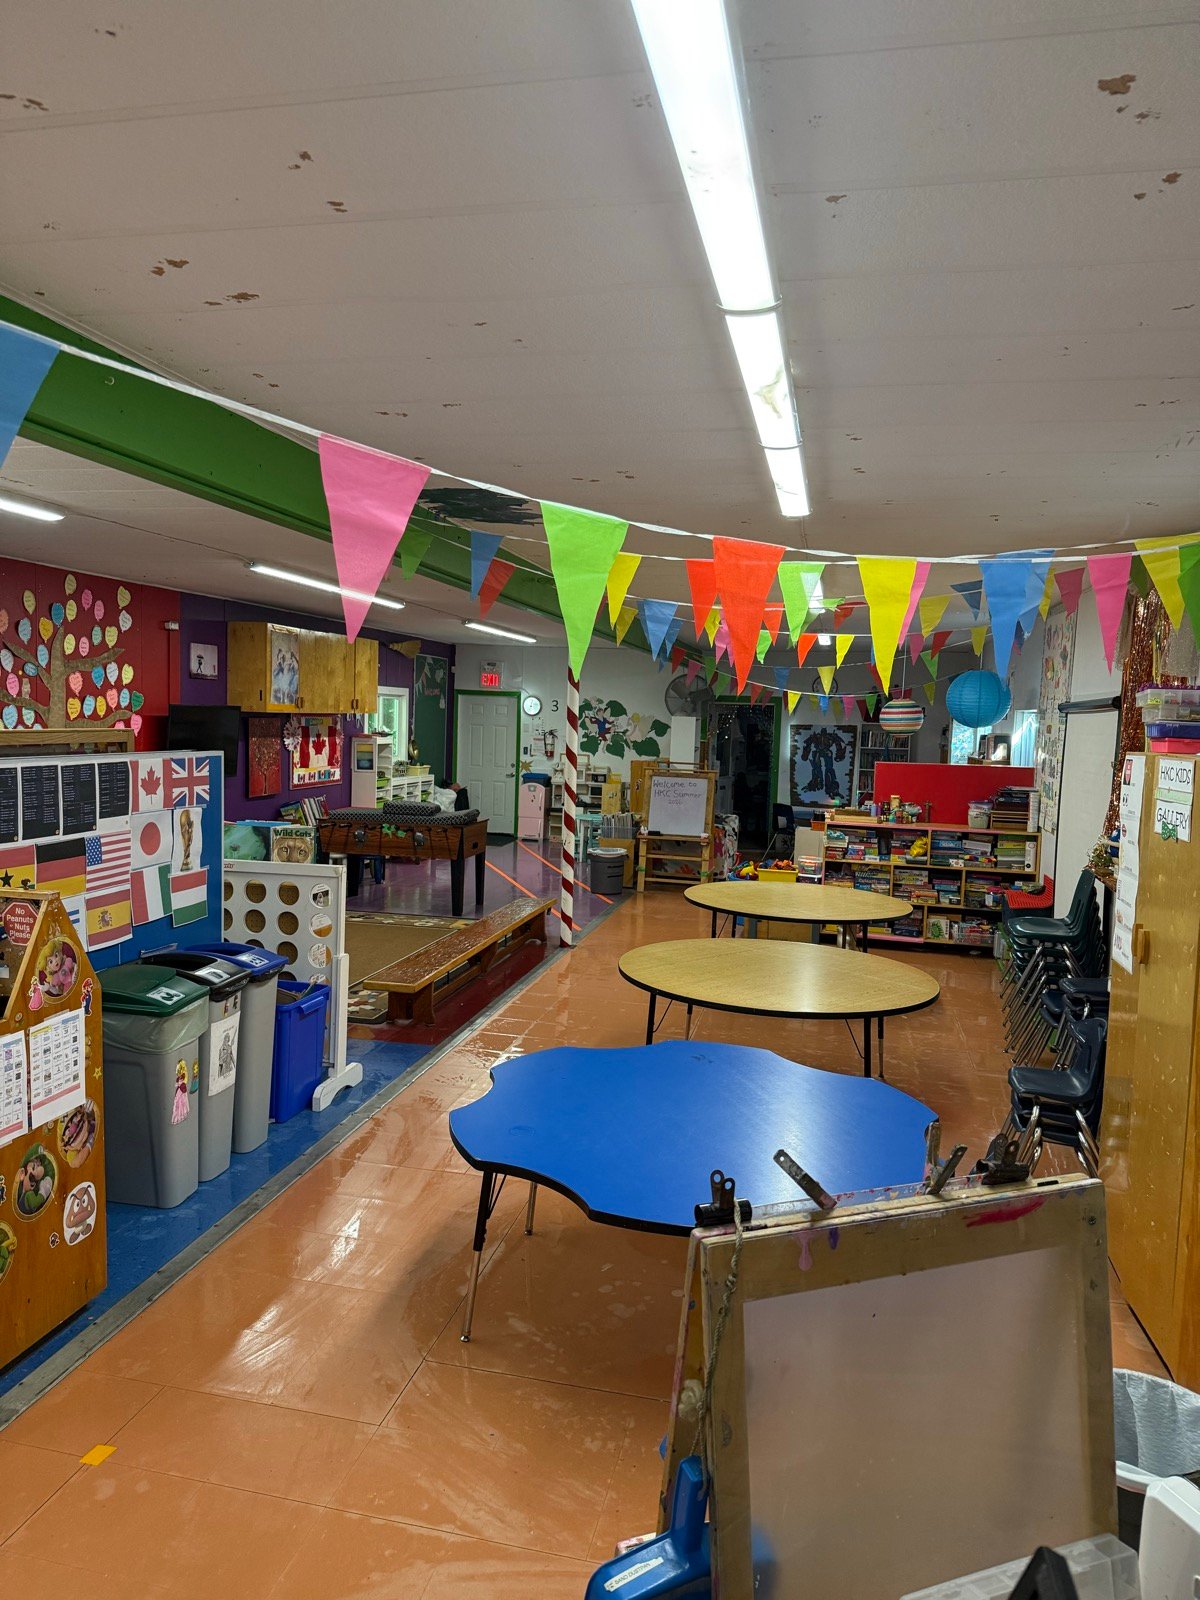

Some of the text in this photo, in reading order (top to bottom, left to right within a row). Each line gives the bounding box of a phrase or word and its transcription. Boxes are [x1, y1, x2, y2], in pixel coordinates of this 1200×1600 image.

[551, 700, 559, 712] 3
[1160, 766, 1191, 785] HKC KIDS
[653, 780, 685, 788] Welcome
[654, 789, 701, 798] HKC Summer
[1157, 807, 1189, 829] GALLERY
[273, 829, 312, 838] Wild Cats
[15, 907, 25, 915] No
[6, 914, 34, 924] Peanuts
[14, 923, 30, 931] Nuts
[9, 930, 31, 938] Please
